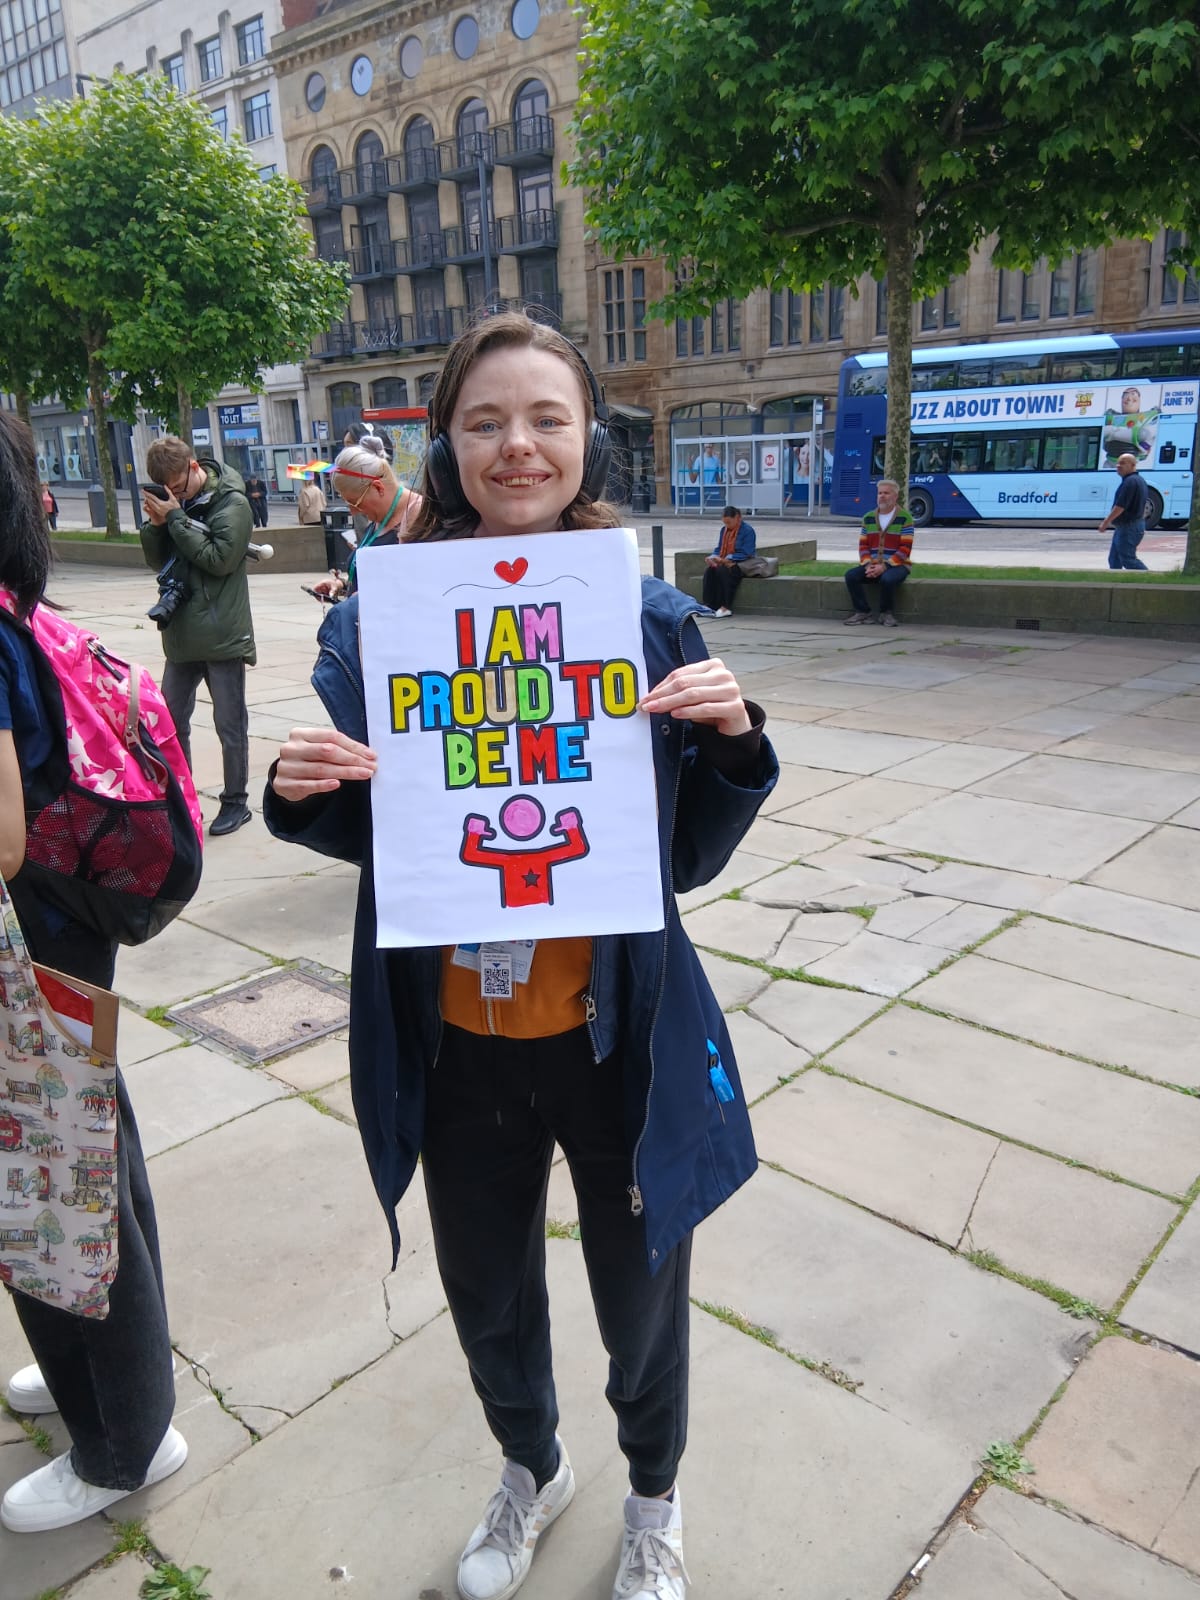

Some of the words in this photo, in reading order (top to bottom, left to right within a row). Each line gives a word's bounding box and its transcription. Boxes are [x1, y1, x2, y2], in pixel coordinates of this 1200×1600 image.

[910, 402, 939, 420] UZZ
[943, 398, 1001, 419] ABOUT
[1005, 395, 1065, 416] TOWN!
[1163, 397, 1183, 406] JUNE
[1184, 396, 1194, 406] 19
[220, 416, 229, 424] TO
[230, 414, 240, 424] LET
[998, 491, 1058, 504] Bradford
[455, 608, 477, 668] I
[485, 601, 564, 666] AM
[388, 663, 553, 734] PROUD
[559, 657, 639, 721] TO
[442, 726, 512, 791] BE
[516, 722, 592, 786] ME
